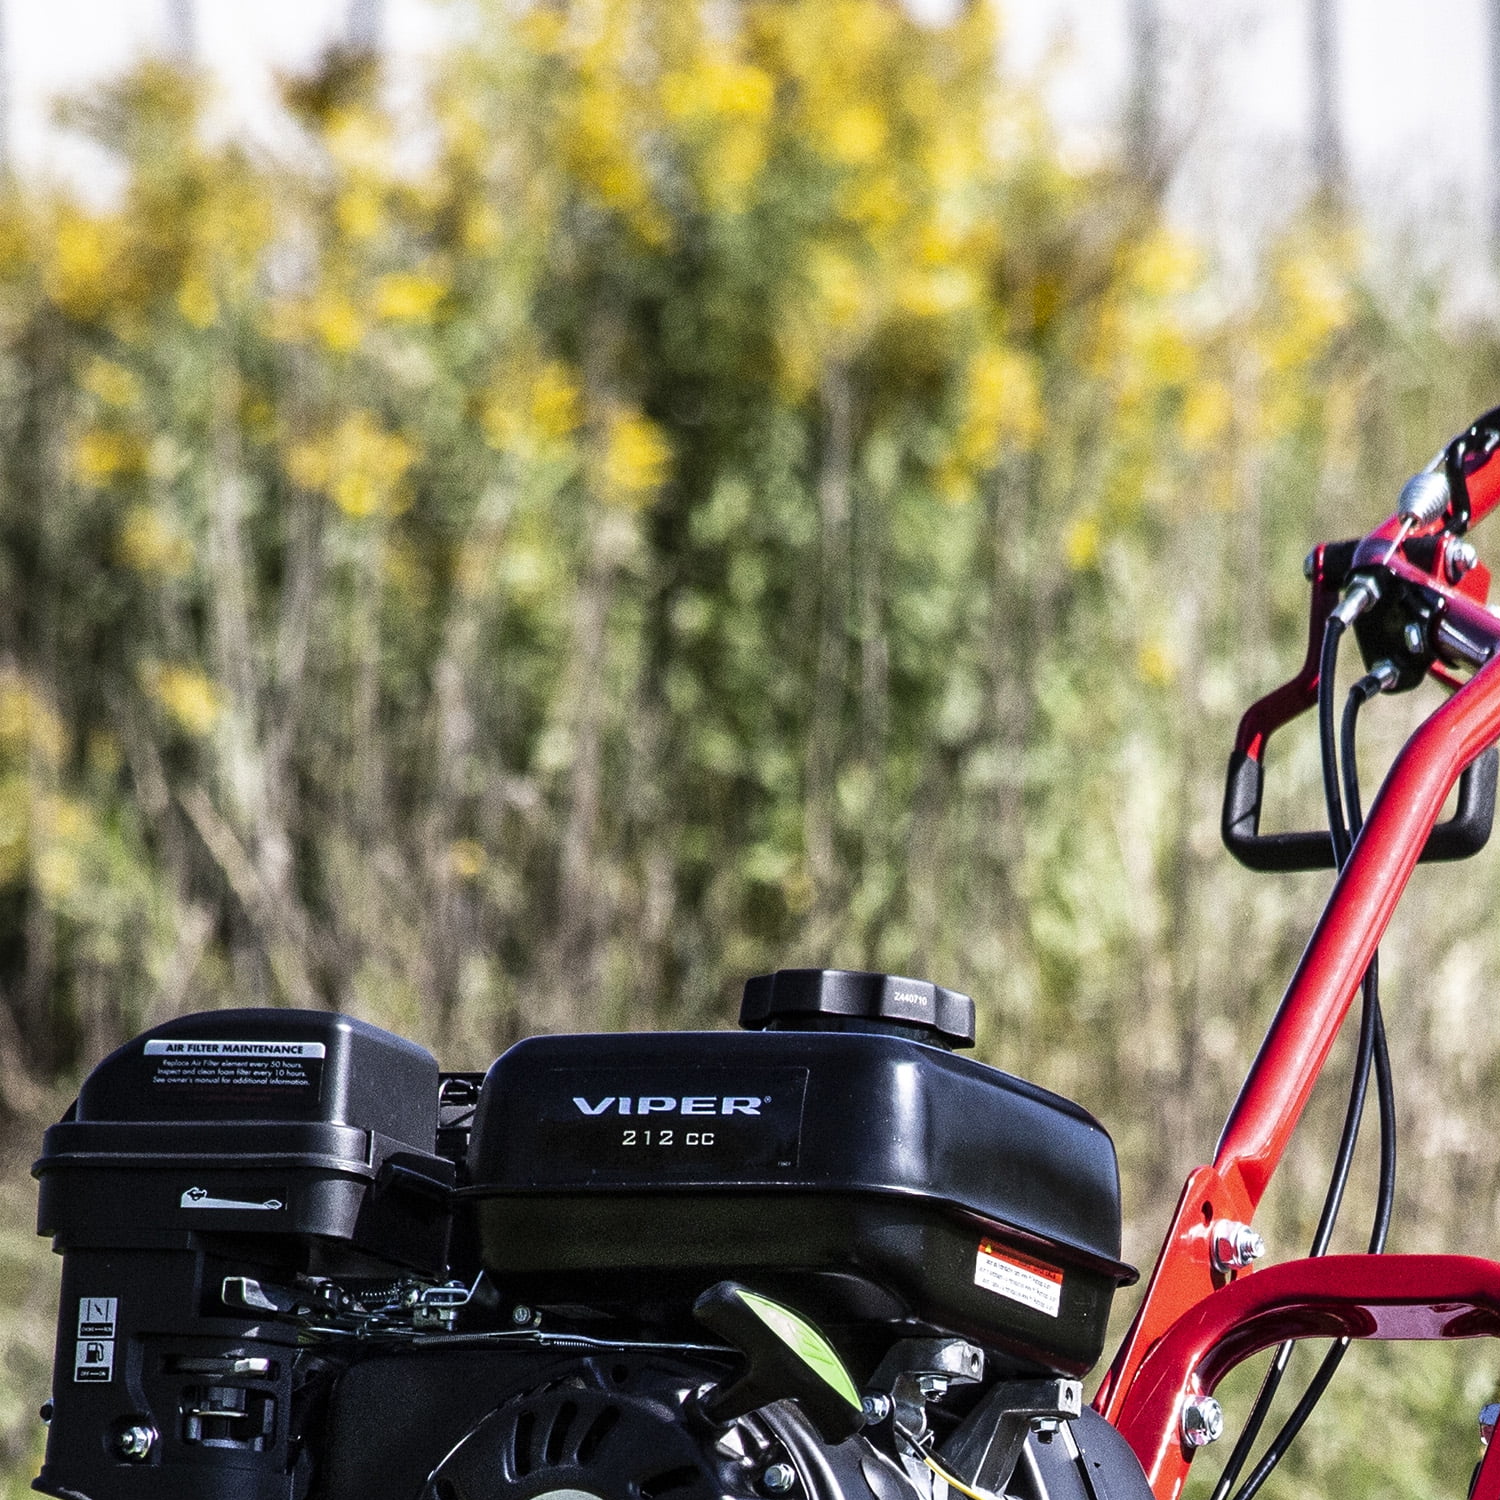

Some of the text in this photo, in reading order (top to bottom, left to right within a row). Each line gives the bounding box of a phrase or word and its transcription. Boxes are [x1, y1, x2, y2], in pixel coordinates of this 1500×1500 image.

[165, 1043, 304, 1055] AIR FILTER MAINTENANCE
[163, 1060, 189, 1068] Replace
[249, 1061, 268, 1069] every
[157, 1068, 181, 1076] Inspect
[253, 1069, 272, 1077] every
[232, 1077, 268, 1085] additional
[573, 1096, 762, 1116] VIPER
[622, 1130, 674, 1146] 212
